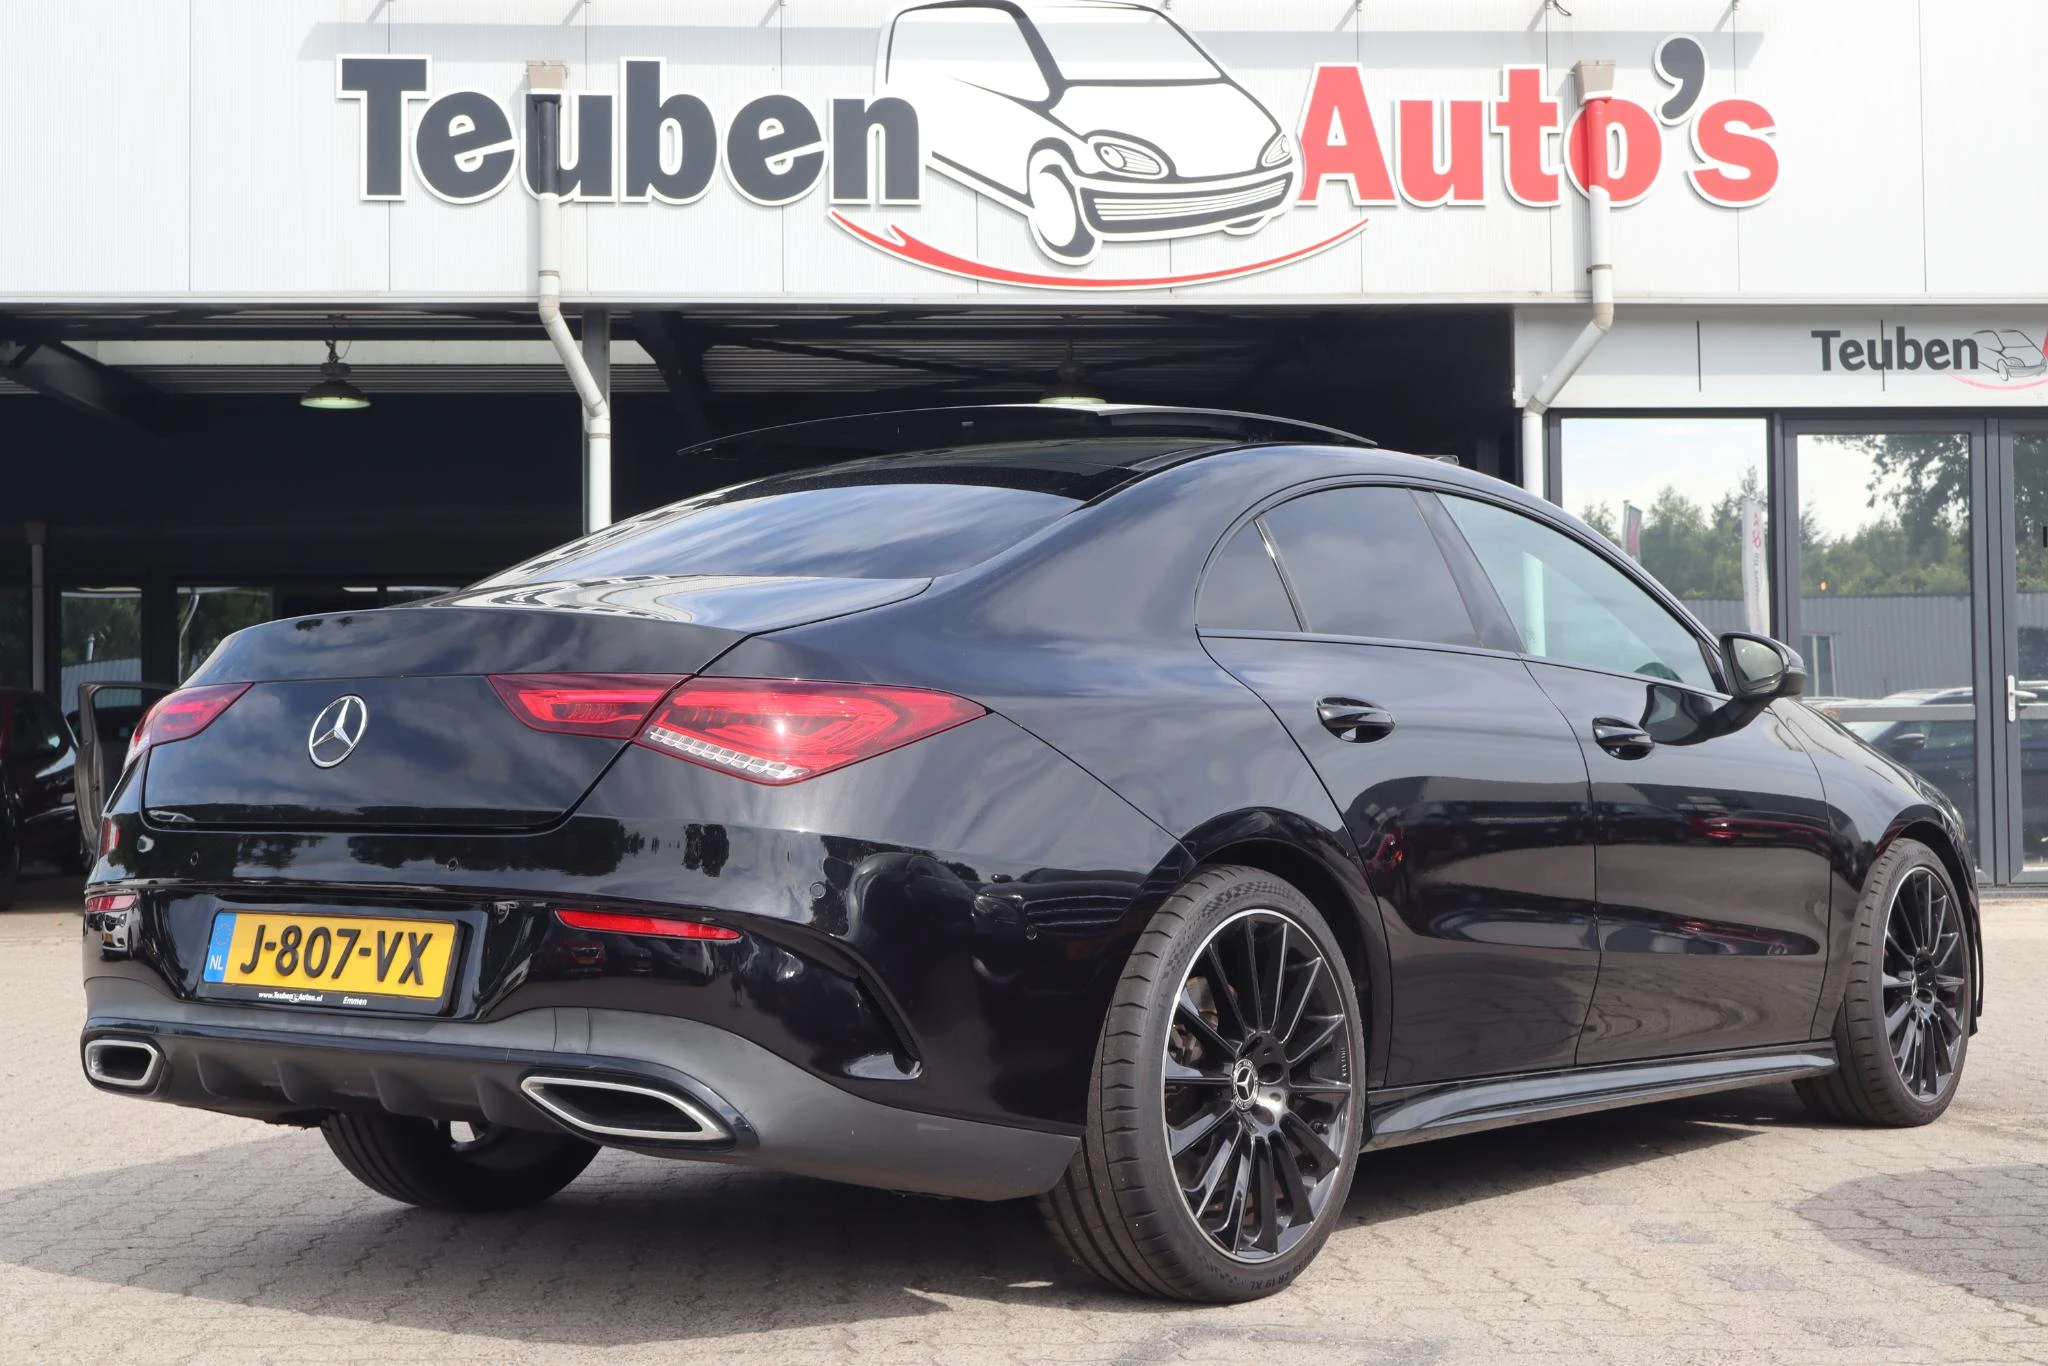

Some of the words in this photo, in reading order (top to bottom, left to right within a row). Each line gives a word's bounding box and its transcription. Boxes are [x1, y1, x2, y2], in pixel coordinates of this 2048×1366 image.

[339, 56, 921, 205] Teuben
[1297, 36, 1780, 203] Auto's
[1811, 326, 1979, 371] Teuben
[209, 954, 223, 970] NL
[239, 924, 434, 985] J-807-VX
[342, 995, 368, 1006] Emmen
